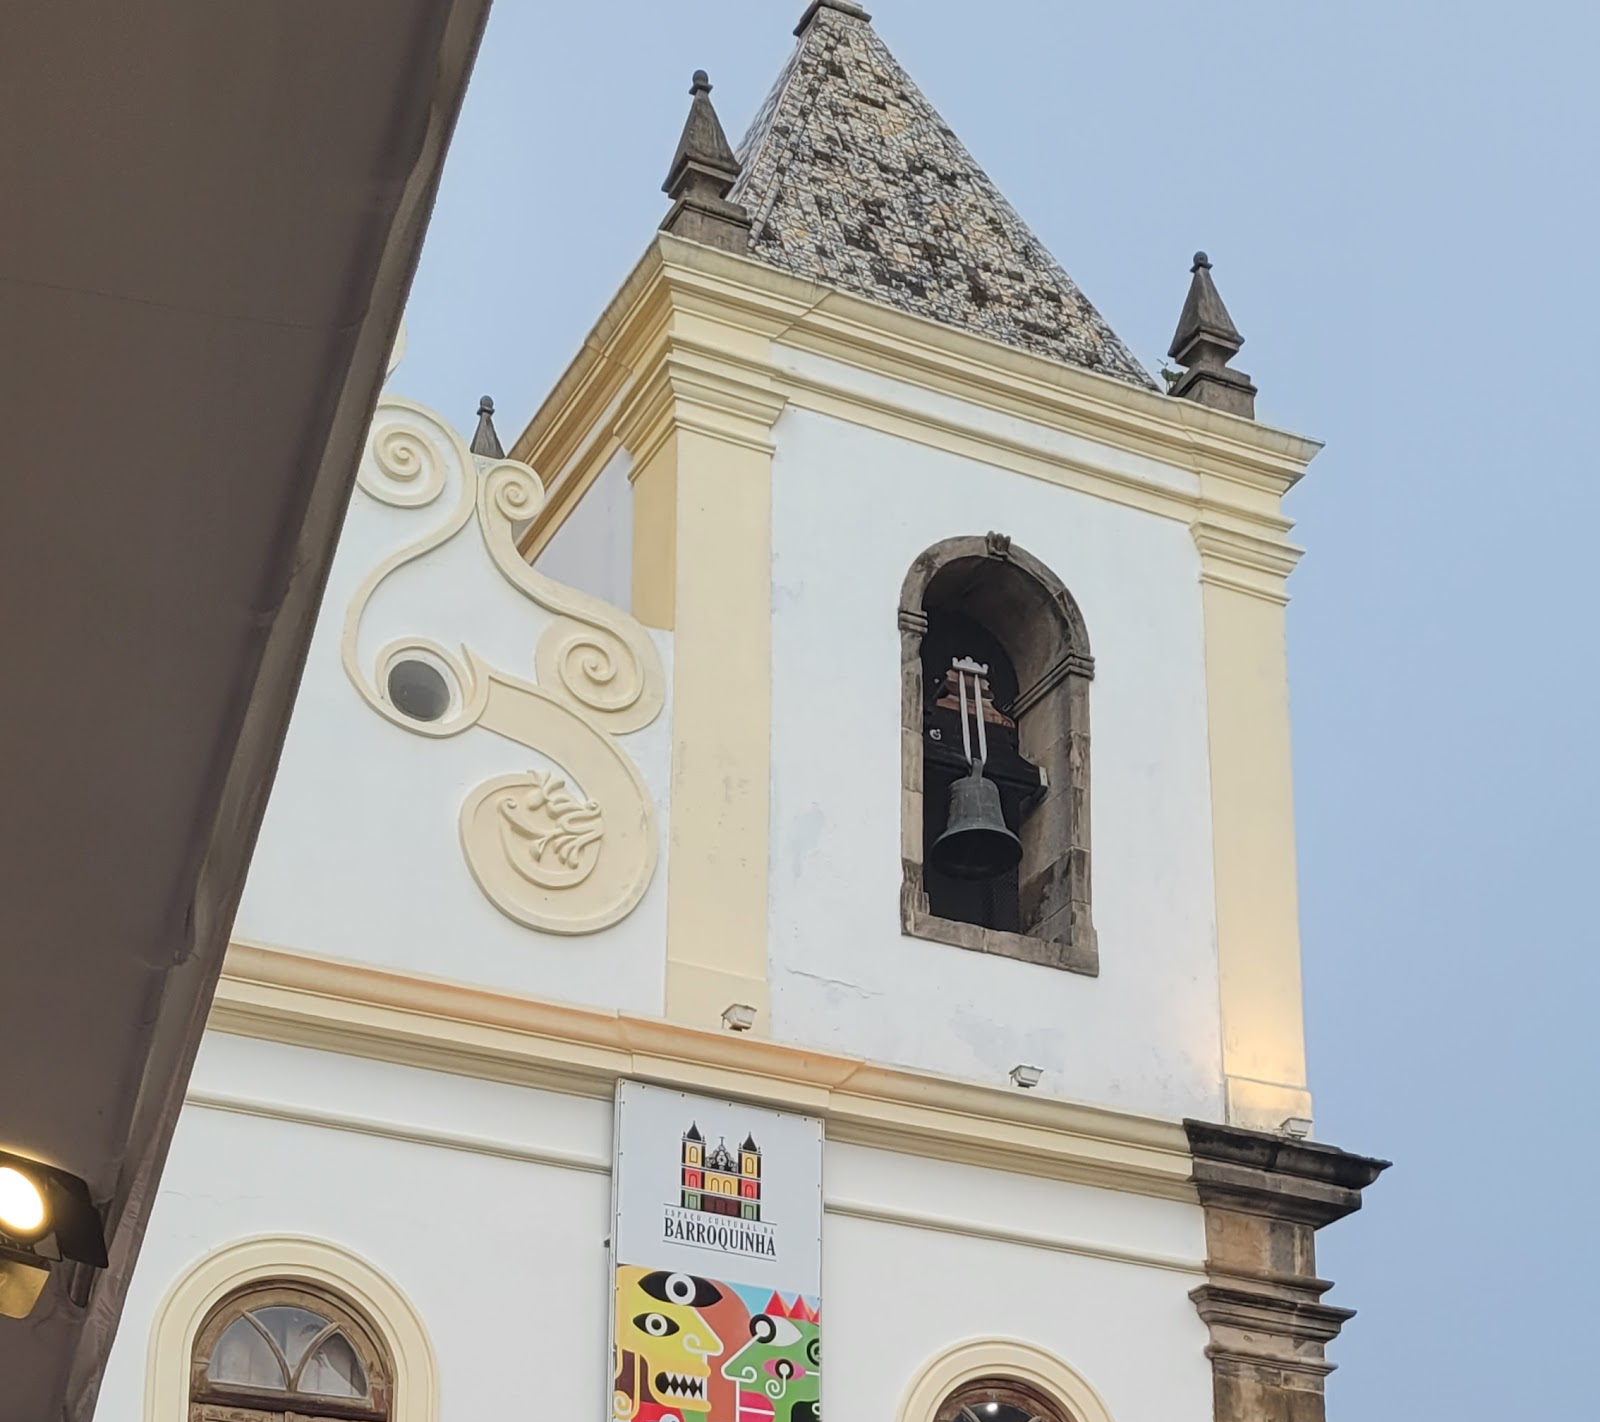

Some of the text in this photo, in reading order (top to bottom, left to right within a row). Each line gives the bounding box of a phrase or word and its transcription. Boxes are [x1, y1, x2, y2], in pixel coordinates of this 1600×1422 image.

[664, 1208, 775, 1235] ESPAÇO CULTURAL DA
[664, 1216, 776, 1256] BARROQUINHA
